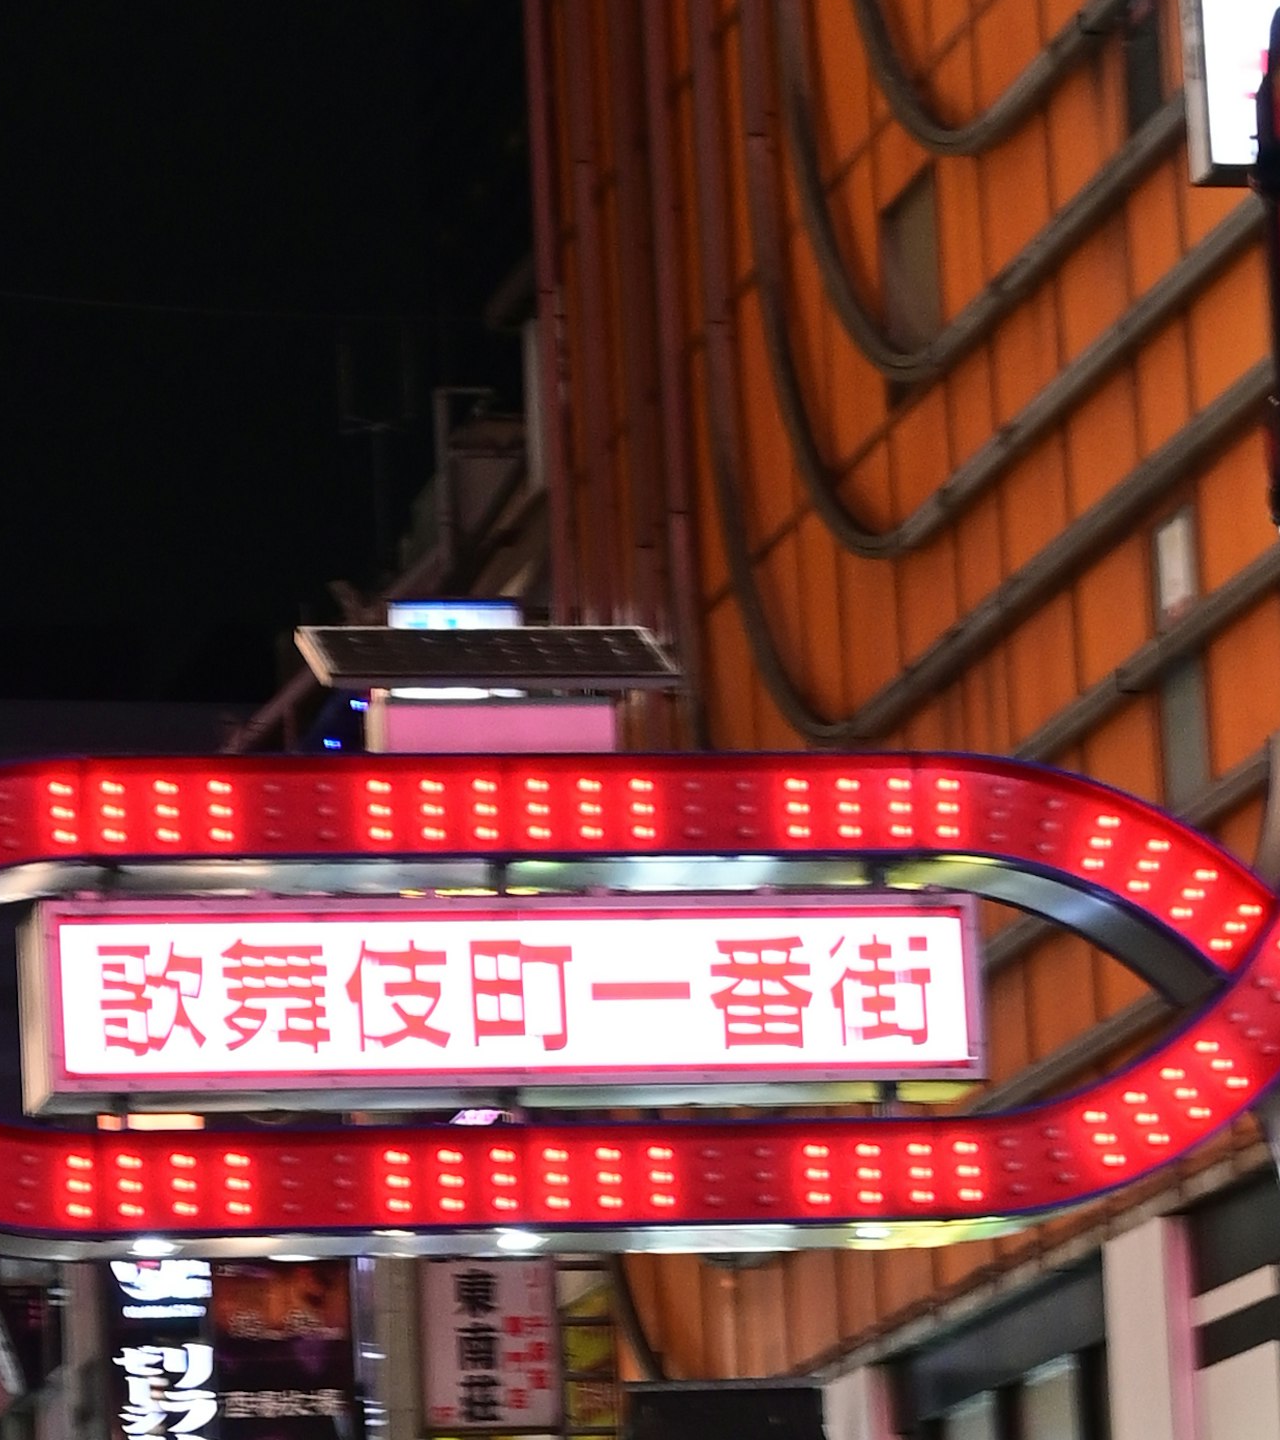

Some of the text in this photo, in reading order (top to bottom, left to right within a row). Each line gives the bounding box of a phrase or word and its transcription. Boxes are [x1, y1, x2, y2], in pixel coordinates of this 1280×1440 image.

[97, 935, 931, 1058] 歌舞伎町一番街
